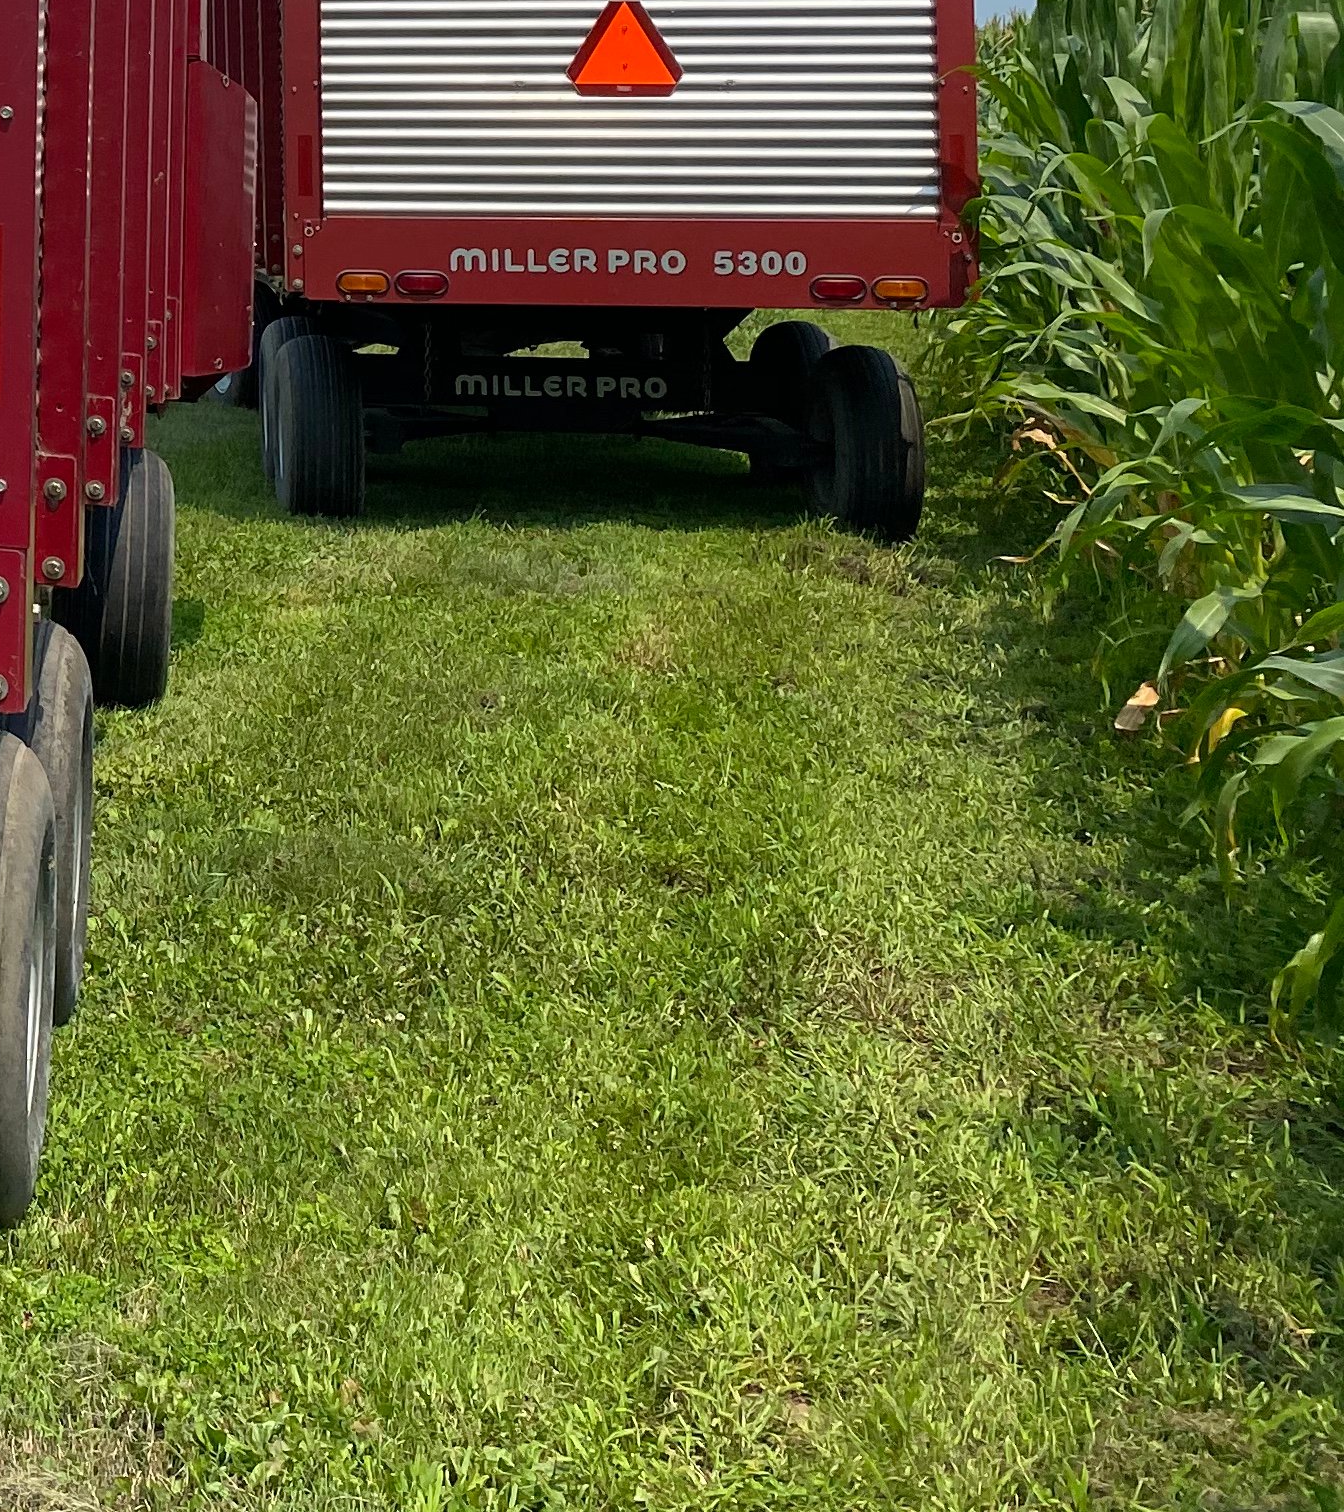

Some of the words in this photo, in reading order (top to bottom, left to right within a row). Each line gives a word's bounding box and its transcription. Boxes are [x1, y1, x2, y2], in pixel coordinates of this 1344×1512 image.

[450, 247, 598, 273] MILLER
[607, 249, 686, 274] PRO
[713, 250, 807, 276] 5300
[454, 374, 588, 398] MILLER
[596, 376, 667, 399] PRO
